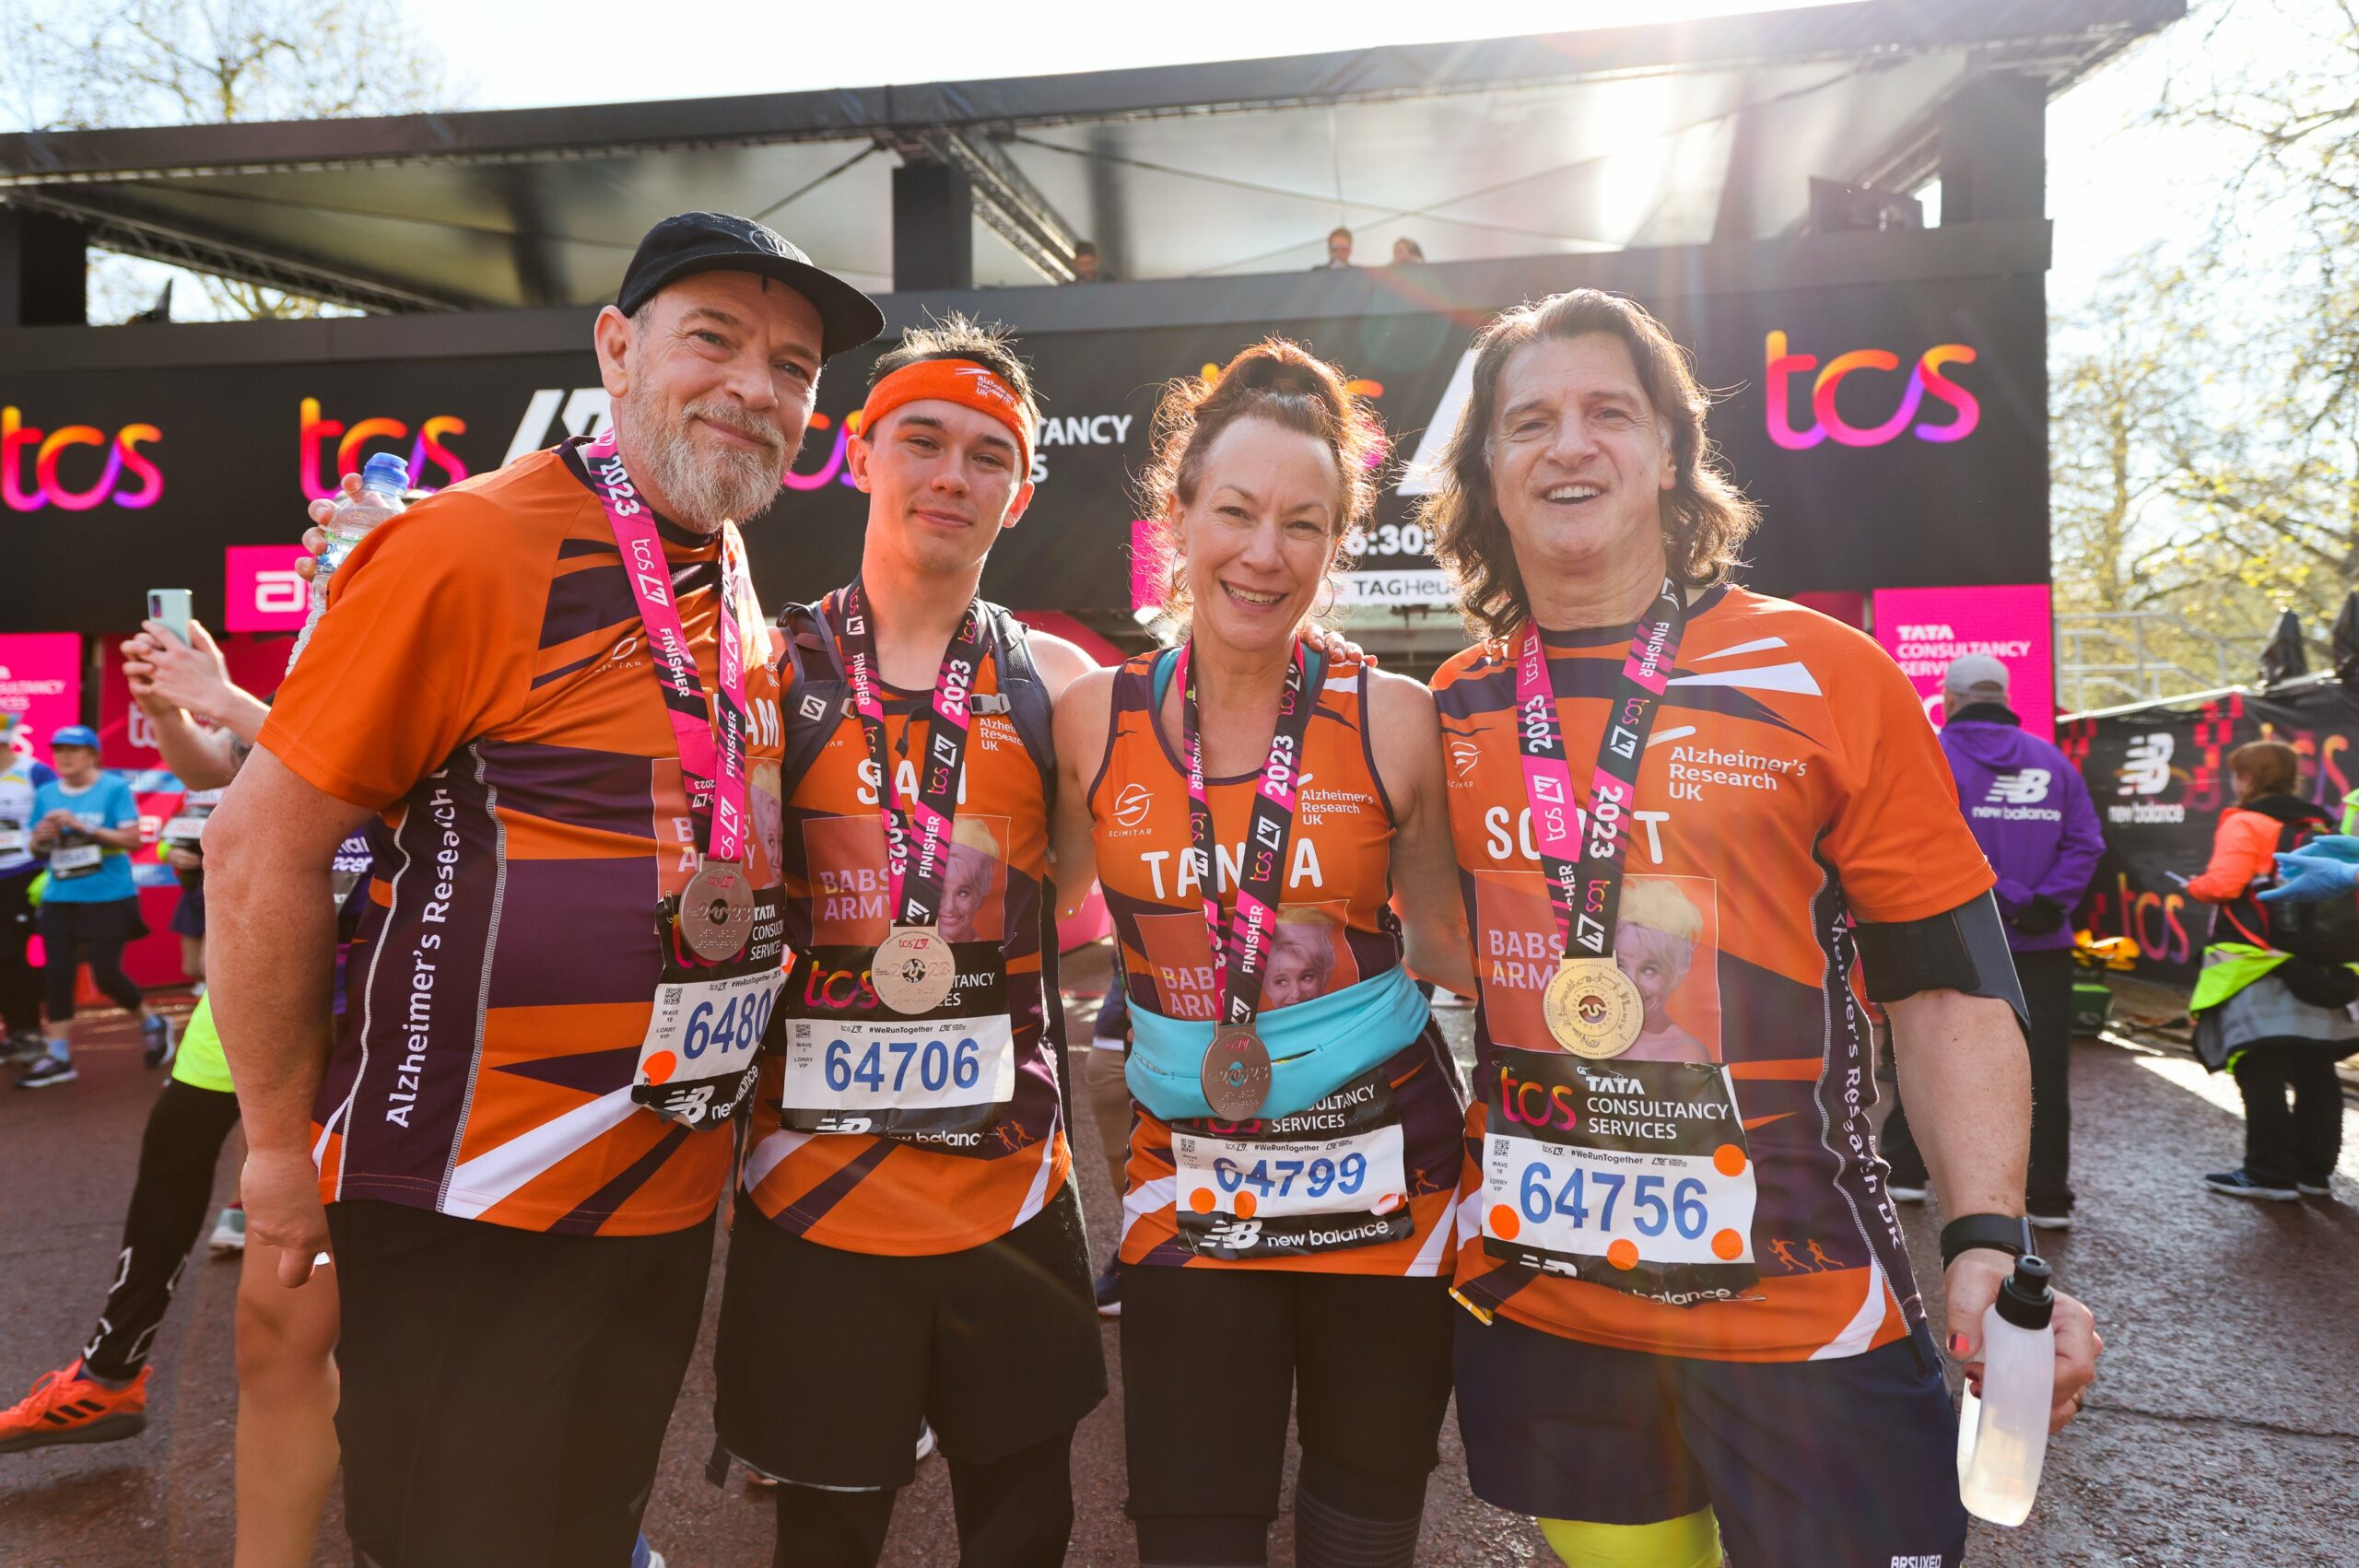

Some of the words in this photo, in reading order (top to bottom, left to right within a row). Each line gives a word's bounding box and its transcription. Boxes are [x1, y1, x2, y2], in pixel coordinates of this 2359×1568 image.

[977, 388, 989, 399] UK
[1766, 330, 1980, 450] tcs
[2, 405, 164, 513] tcs
[601, 455, 640, 517] 2023
[631, 538, 654, 571] tcs
[957, 618, 977, 645] tcs
[1896, 625, 1954, 640] TATA
[660, 627, 690, 697] FINISHER
[1638, 622, 1670, 679] FINISHER
[1896, 641, 2032, 659] CONSULTANCY
[852, 652, 870, 707] FINISHER
[941, 659, 970, 716] 2023
[980, 718, 1016, 733] Alzhei
[1525, 695, 1552, 754] 2023
[1622, 697, 1650, 726] tcs
[726, 710, 737, 778] FINISHER
[980, 728, 1024, 745] Researc
[981, 740, 999, 751] UK
[1264, 734, 1293, 797] 2023
[1670, 746, 1807, 777] Alzheimer's
[927, 766, 949, 795] tcs
[1669, 764, 1778, 791] Research
[1669, 783, 1703, 802] UK
[1301, 790, 1373, 804] Alzheimer's
[1302, 802, 1360, 814] Research
[1190, 812, 1207, 842] tcs
[1302, 814, 1323, 825] UK
[1546, 807, 1567, 843] tcs
[1589, 785, 1624, 859] 2023
[1971, 806, 2003, 818] new
[2004, 807, 2061, 822] balance
[919, 815, 941, 878] FINISHER
[1109, 828, 1152, 837] SCIMITAR
[1140, 837, 1323, 900] TANA
[1250, 850, 1273, 882] tcs
[824, 895, 890, 920] ARM
[1586, 880, 1611, 913] tcs
[1241, 905, 1263, 973] FINISHER
[1488, 930, 1564, 960] BABS
[804, 960, 879, 1009] tcs
[385, 933, 440, 1129] Alzheimer's
[684, 984, 783, 1059] 6480
[869, 1025, 933, 1035] #WeRunTogether
[825, 1037, 980, 1092] 64706
[1500, 1066, 1577, 1131] tcs
[1585, 1077, 1645, 1094] TATA
[1272, 1113, 1345, 1133] SERVICES
[1586, 1097, 1729, 1120] CONSULTANCY
[916, 1129, 980, 1146] balanc
[1588, 1117, 1677, 1141] SERVICES
[1254, 1144, 1320, 1153] #WeRunTogether
[1571, 1149, 1644, 1164] #WeRunTogether
[1213, 1152, 1367, 1198] 64799
[1520, 1162, 1708, 1240] 64756
[1267, 1231, 1304, 1247] new
[1309, 1219, 1390, 1246] balance
[1877, 1202, 1901, 1251] UK
